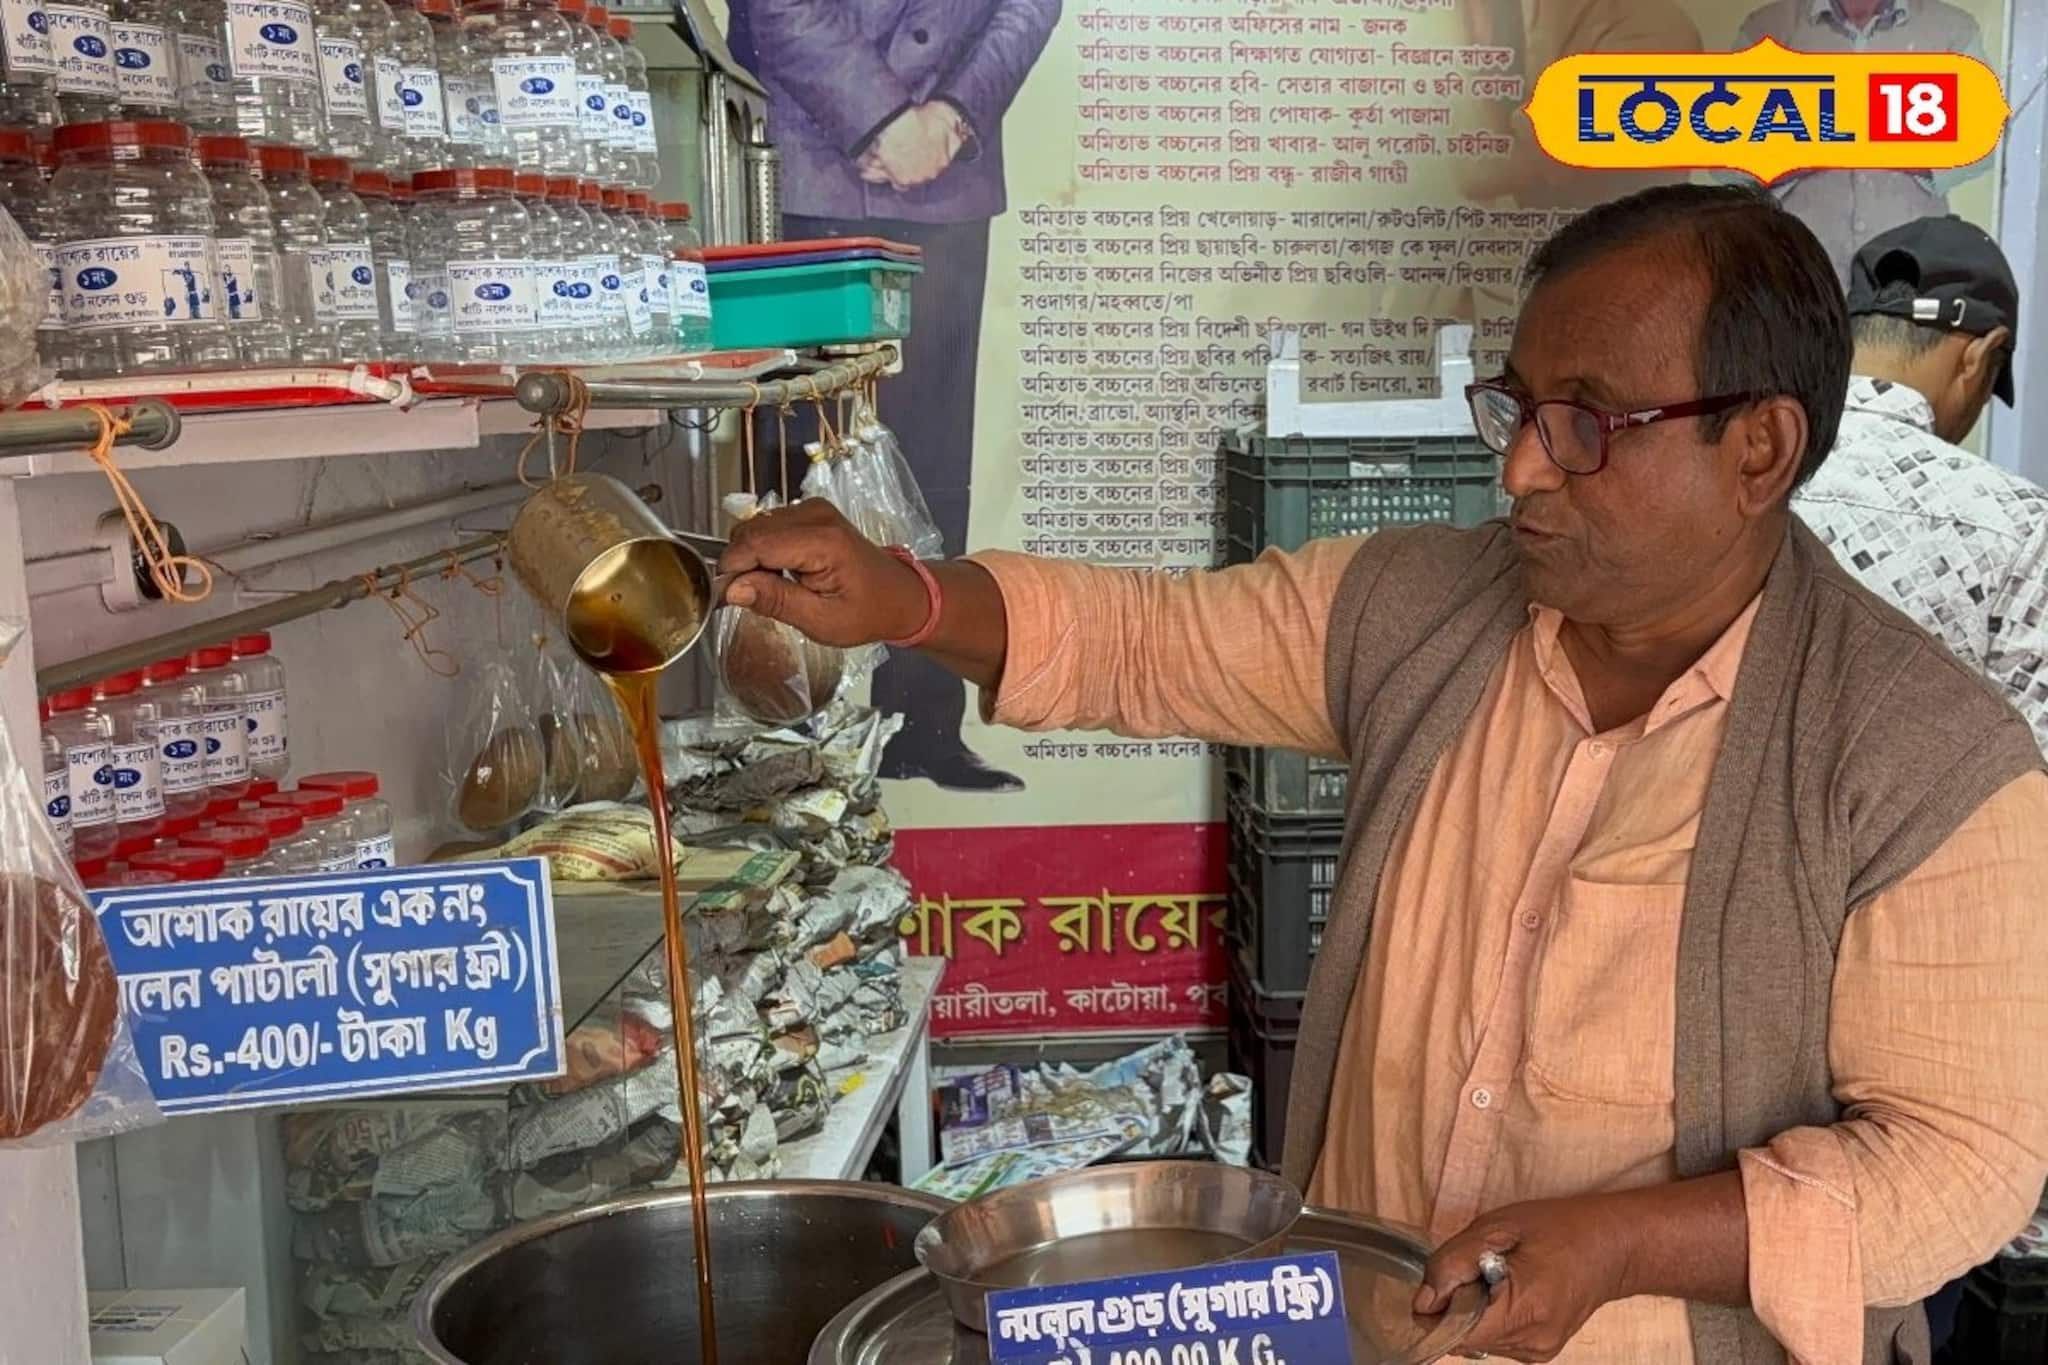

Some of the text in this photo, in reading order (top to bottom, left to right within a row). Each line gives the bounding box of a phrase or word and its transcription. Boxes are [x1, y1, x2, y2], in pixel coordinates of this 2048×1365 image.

[1078, 8, 1150, 33] অমিতাভ
[1155, 16, 1222, 33] বচ্চনের
[1228, 11, 1303, 34] অফিসের
[1309, 18, 1340, 34] নাম
[1362, 18, 1408, 35] জনক
[1078, 38, 1150, 62] অমিতাভ
[1155, 46, 1222, 63] বচ্চনের
[1078, 68, 1150, 92] অমিতাভ
[1155, 76, 1222, 93] বচ্চনের
[1278, 77, 1332, 95] সেতার
[1340, 78, 1405, 96] বাজানো
[1413, 79, 1426, 94] ও
[1434, 72, 1464, 97] ছবি
[1472, 79, 1521, 97] তোলা
[1078, 98, 1150, 122] অমিতাভ
[1155, 106, 1222, 123] বচ্চনের
[1229, 99, 1260, 123] প্রিয়
[1390, 107, 1450, 125] পাজামা
[1078, 128, 1150, 152] অমিতাভ
[1155, 136, 1222, 153] বচ্চনের
[1229, 129, 1260, 153] প্রিয়
[1078, 158, 1150, 182] অমিতাভ
[1155, 165, 1222, 183] বচ্চনের
[1229, 159, 1260, 183] প্রিয়
[1311, 160, 1362, 182] রাজীব
[1019, 204, 1087, 227] অমিতাভ
[1092, 211, 1153, 228] বচ্চনের
[1160, 205, 1190, 228] প্রিয়
[1019, 232, 1087, 255] অমিতাভ
[1092, 239, 1153, 256] বচ্চনের
[1160, 233, 1190, 256] প্রিয়
[1019, 261, 1087, 283] অমিতাভ
[1092, 267, 1153, 284] বচ্চনের
[1160, 261, 1212, 284] নিজের
[1288, 261, 1318, 284] প্রিয়
[1020, 316, 1088, 338] অমিতাভ
[1092, 322, 1153, 339] বচ্চনের
[1160, 316, 1190, 339] প্রিয়
[1196, 316, 1249, 339] বিদেশী
[1020, 343, 1088, 365] অমিতাভ
[1092, 350, 1153, 366] বচ্চনের
[1160, 344, 1190, 366] প্রিয়
[1196, 343, 1236, 367] ছবির
[1020, 371, 1088, 393] অমিতাভ
[1092, 378, 1153, 394] বচ্চনের
[1160, 372, 1190, 393] প্রিয়
[1021, 426, 1088, 447] অমিতাভ
[1092, 431, 1153, 448] বচ্চনের
[1160, 426, 1190, 448] প্রিয়
[1021, 453, 1088, 474] অমিতাভ
[1092, 458, 1153, 474] বচ্চনের
[1160, 452, 1190, 474] প্রিয়
[1021, 481, 1088, 502] অমিতাভ
[1092, 486, 1153, 502] বচ্চনের
[1160, 480, 1190, 502] প্রিয়
[1021, 507, 1088, 528] অমিতাভ
[1092, 512, 1153, 529] বচ্চনের
[1160, 507, 1190, 529] প্রিয়
[1021, 534, 1088, 554] অমিতাভ
[1092, 539, 1153, 555] বচ্চনের
[1023, 739, 1089, 760] অমিতাভ
[1094, 742, 1152, 759] বচ্চনের
[121, 899, 254, 949] অশোক
[260, 892, 363, 944] রায়ের
[211, 945, 339, 1004] পাটালী
[338, 1007, 428, 1063] টাকা
[446, 1008, 497, 1059] Kg
